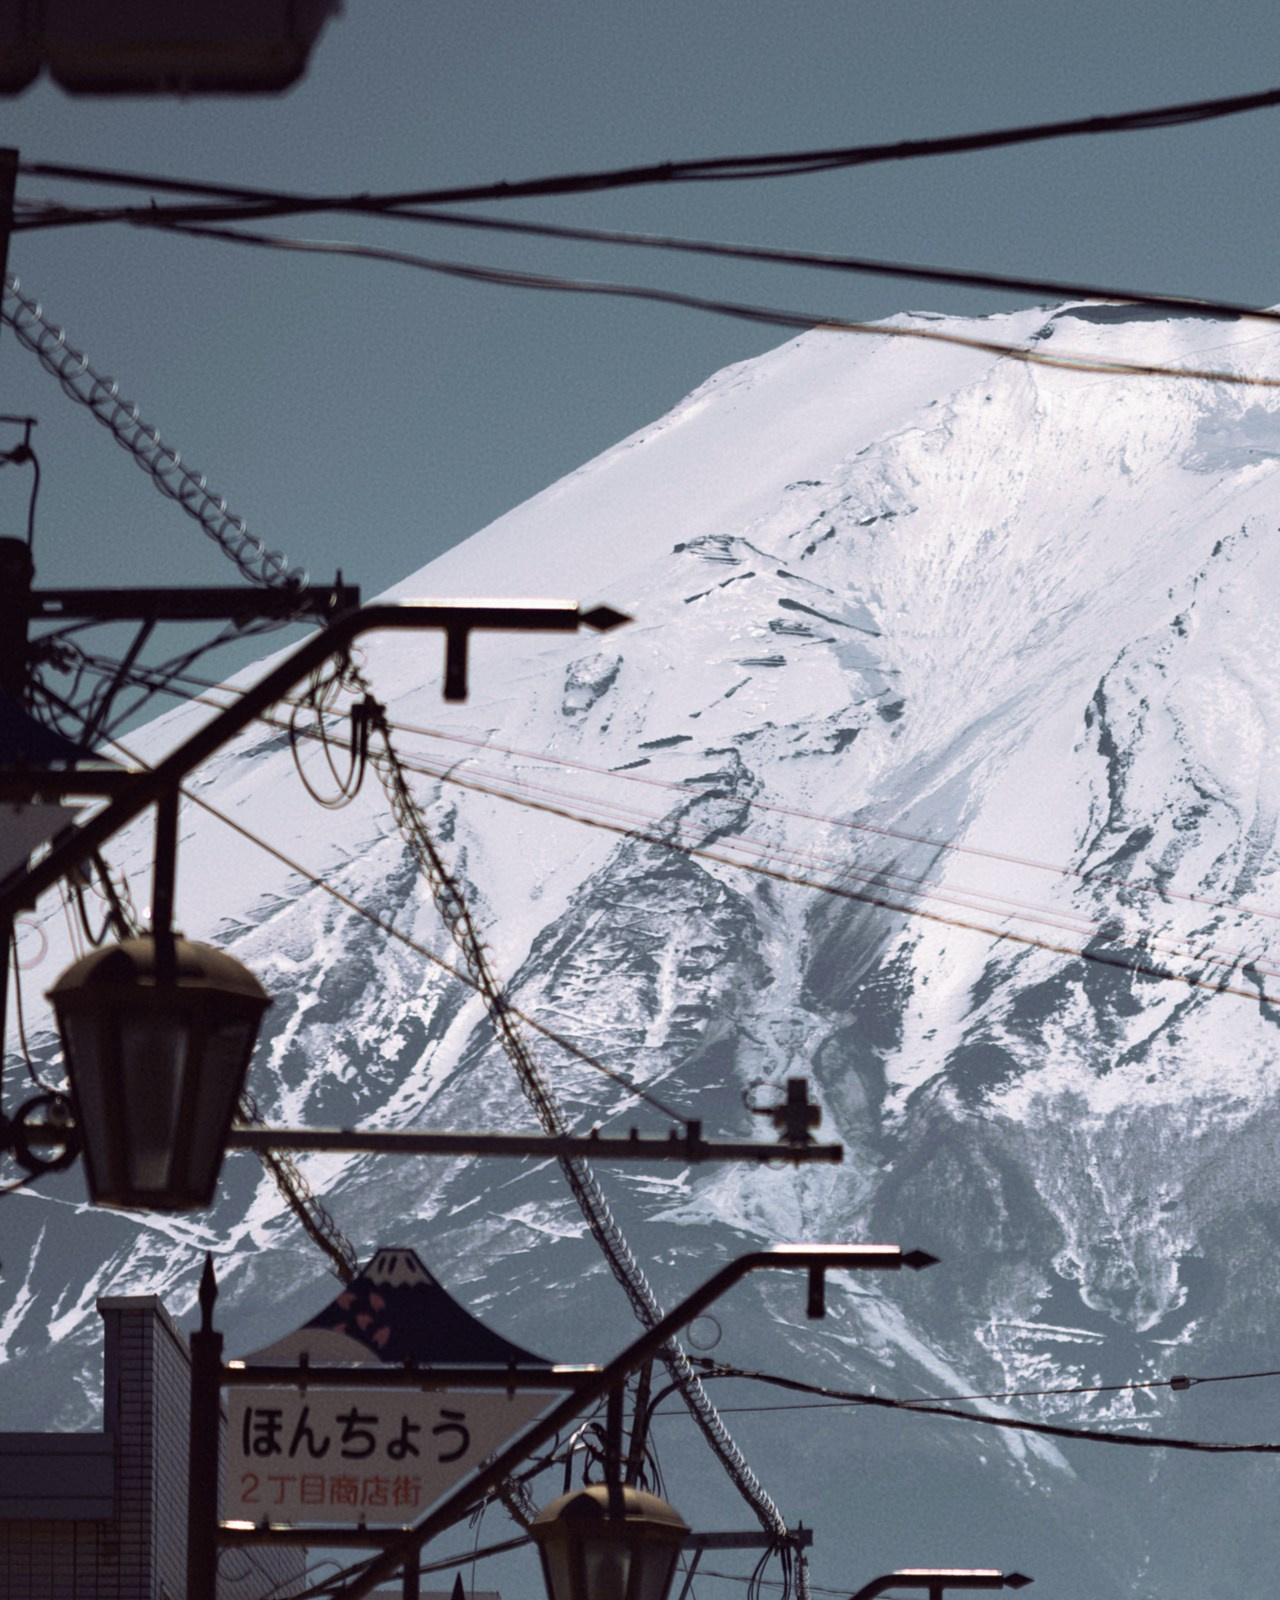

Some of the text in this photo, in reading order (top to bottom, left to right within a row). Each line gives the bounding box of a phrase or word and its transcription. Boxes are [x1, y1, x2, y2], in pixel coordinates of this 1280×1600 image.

[242, 1406, 470, 1463] ほんちょう
[240, 1472, 422, 1507] 2丁目商店街
